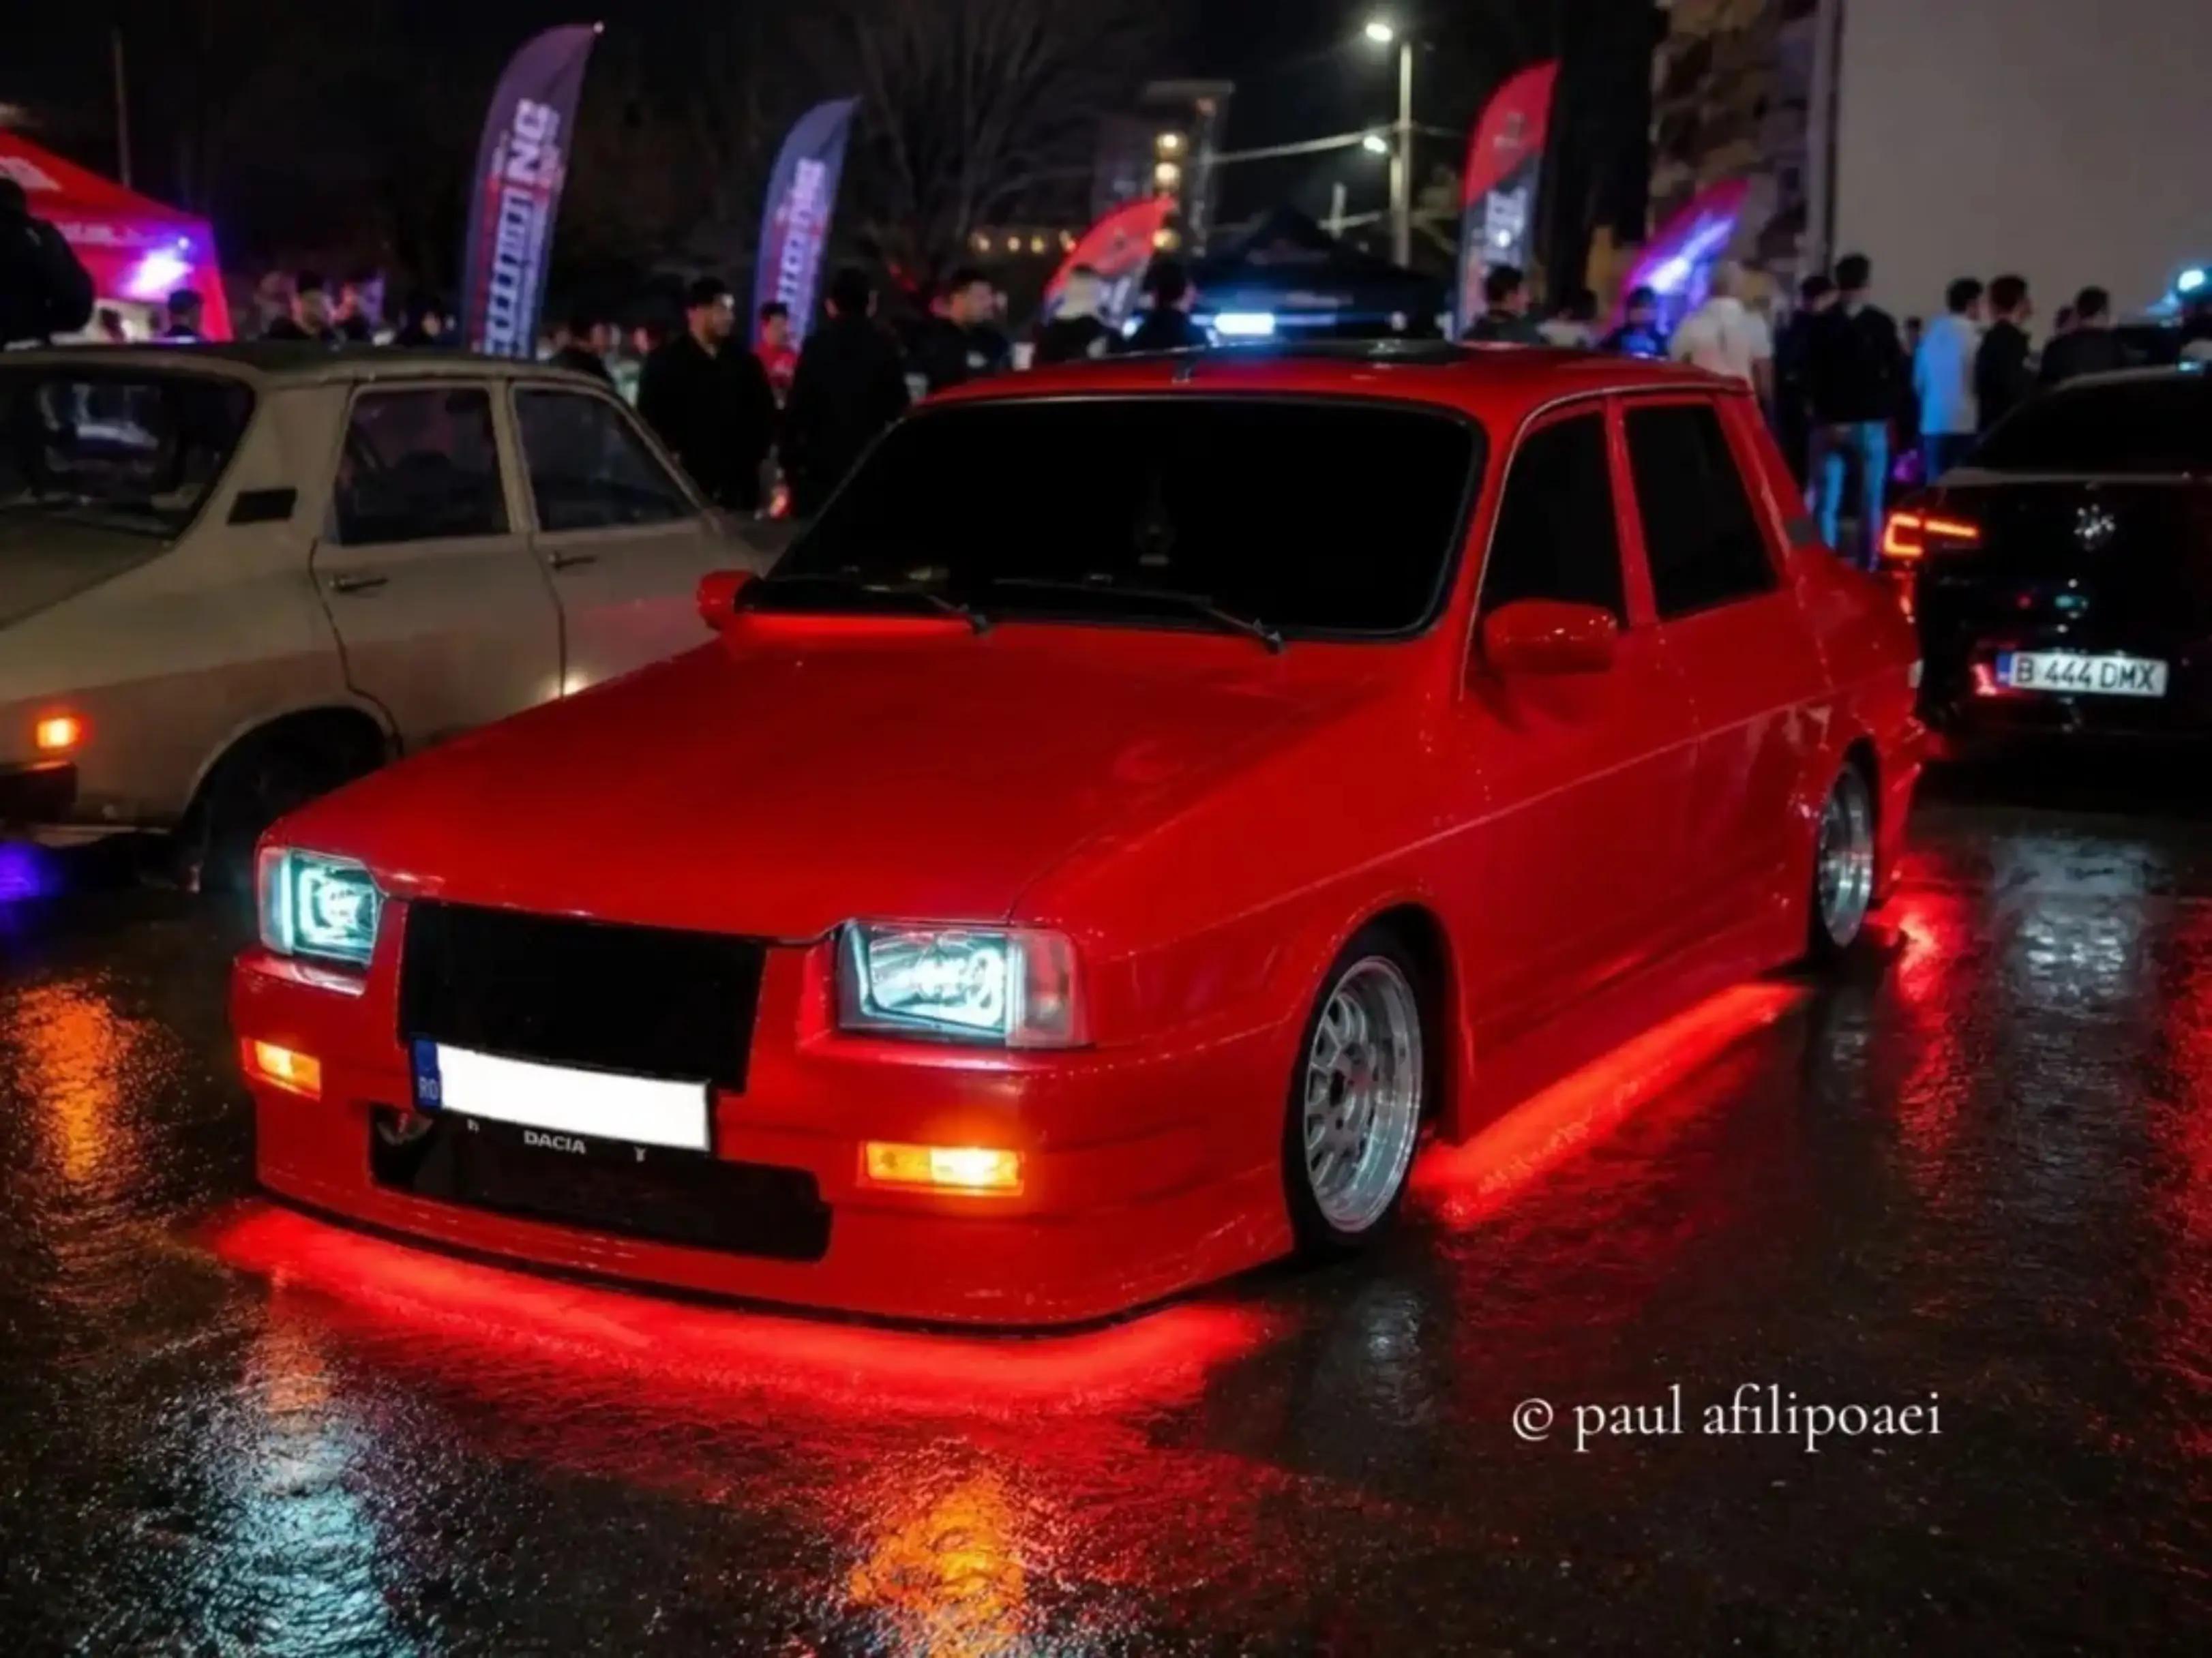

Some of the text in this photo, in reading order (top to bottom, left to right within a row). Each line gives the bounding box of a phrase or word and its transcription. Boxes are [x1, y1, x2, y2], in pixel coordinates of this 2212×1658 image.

[2016, 657, 2155, 691] B 444 DMX
[419, 1076, 439, 1100] RO
[523, 1129, 586, 1155] DACIA
